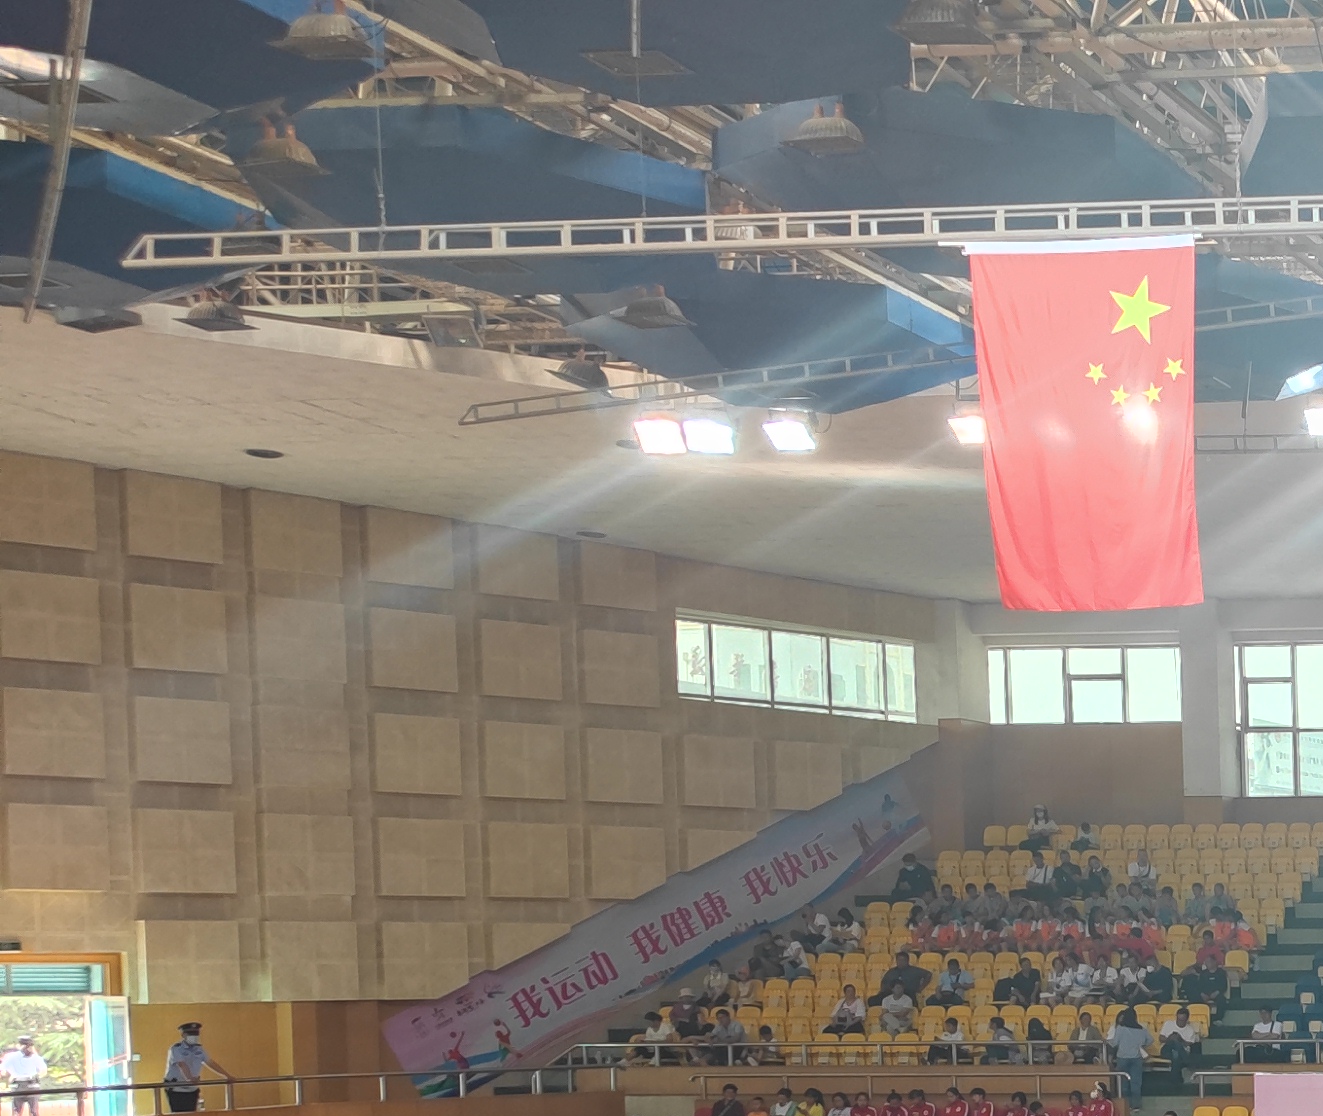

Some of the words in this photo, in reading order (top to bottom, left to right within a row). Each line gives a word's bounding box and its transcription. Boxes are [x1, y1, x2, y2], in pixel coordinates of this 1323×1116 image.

[507, 950, 619, 1028] 我运动
[626, 890, 732, 963] 我健康
[740, 832, 838, 904] 我快乐
